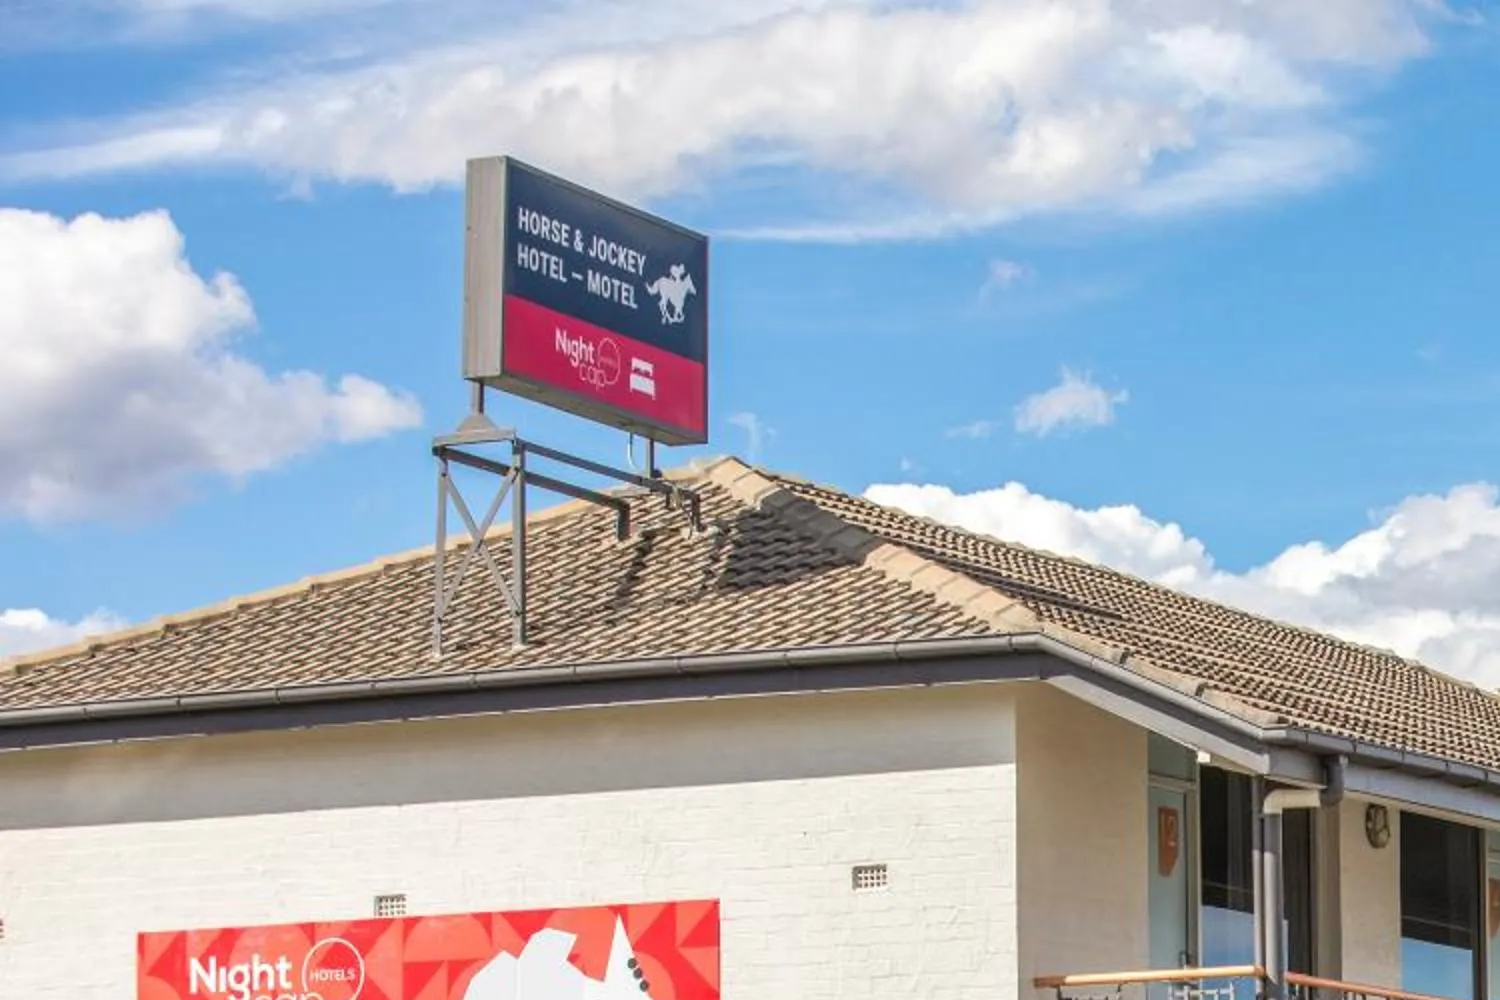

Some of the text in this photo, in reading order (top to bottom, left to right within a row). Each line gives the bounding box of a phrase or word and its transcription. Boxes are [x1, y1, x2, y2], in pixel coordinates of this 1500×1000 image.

[517, 206, 646, 277] HORSE & JOCKEY
[517, 244, 567, 284] HOTEL
[587, 269, 638, 309] MOTEL
[555, 327, 595, 369] Night
[579, 362, 606, 391] cap
[310, 967, 357, 982] HOTELS
